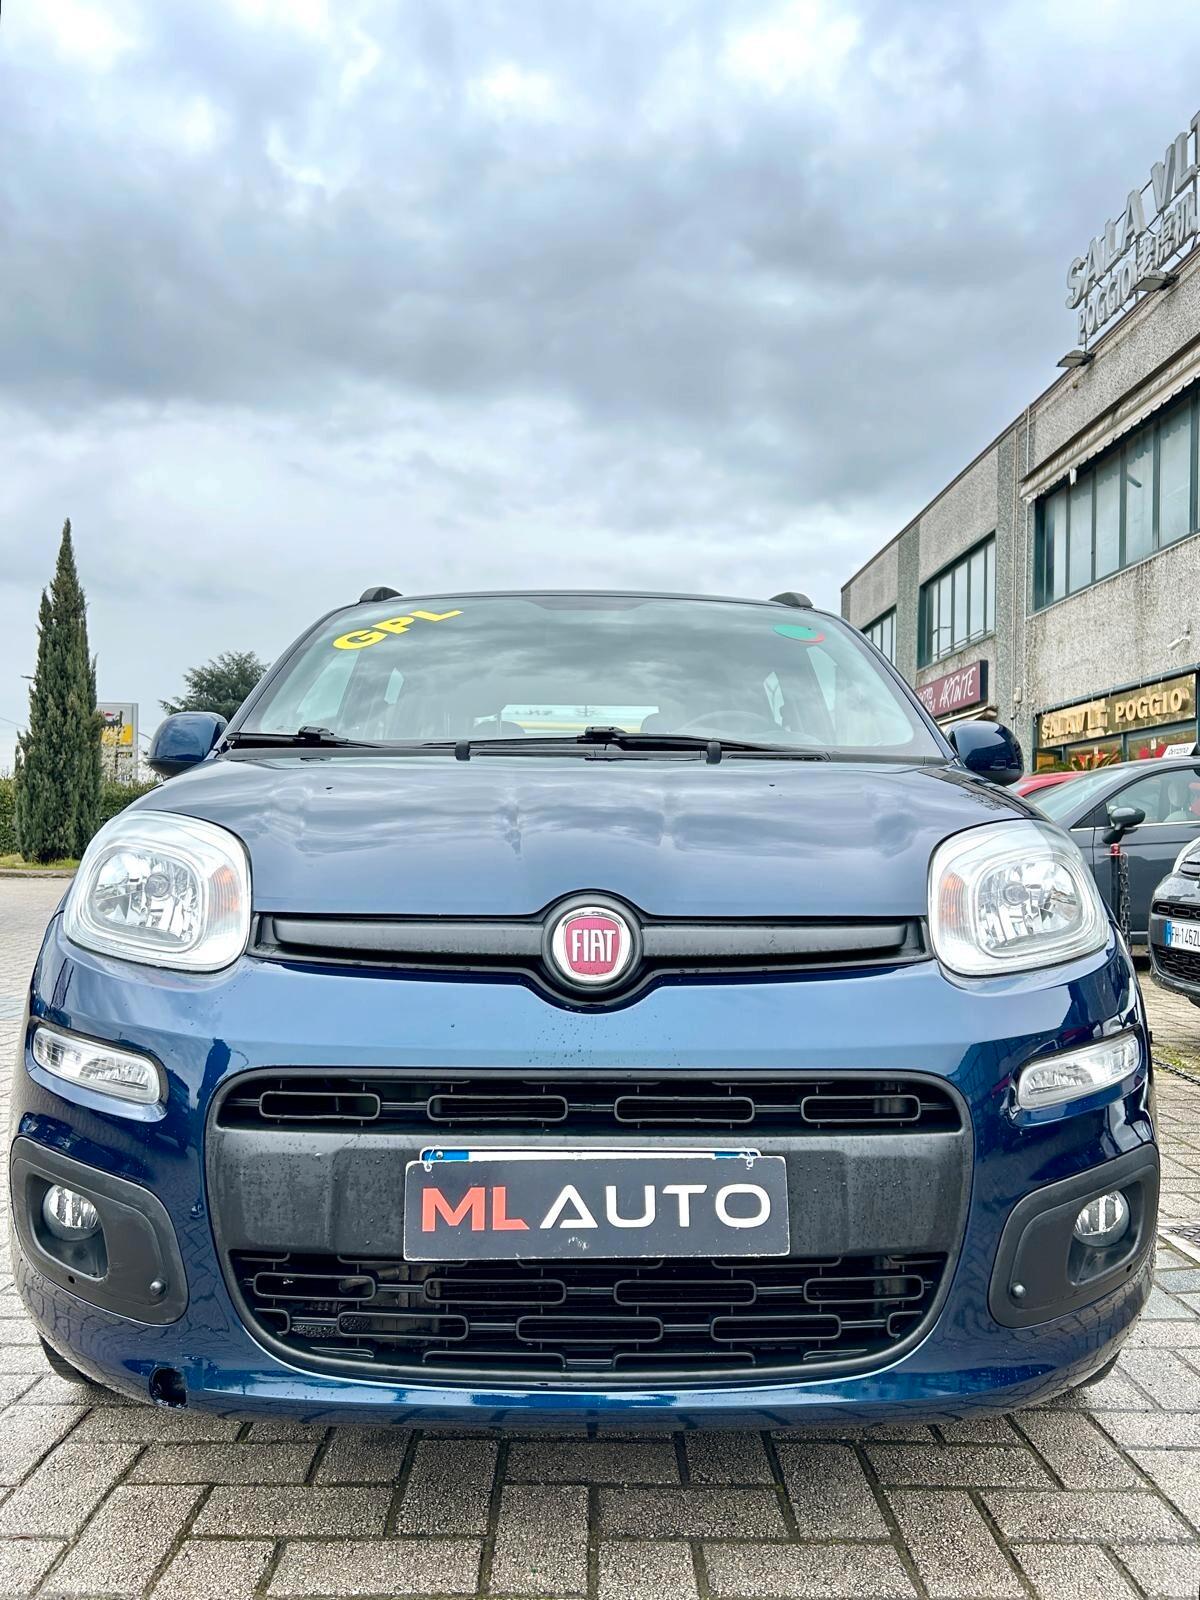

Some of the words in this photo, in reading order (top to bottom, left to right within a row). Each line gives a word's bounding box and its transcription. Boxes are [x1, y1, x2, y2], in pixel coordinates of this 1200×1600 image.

[1065, 188, 1147, 310] SALA
[1078, 259, 1137, 345] POGGIO
[332, 610, 464, 650] GPL
[1115, 688, 1184, 723] POGGIO
[571, 929, 616, 963] FIAT
[540, 1184, 771, 1229] AUTO
